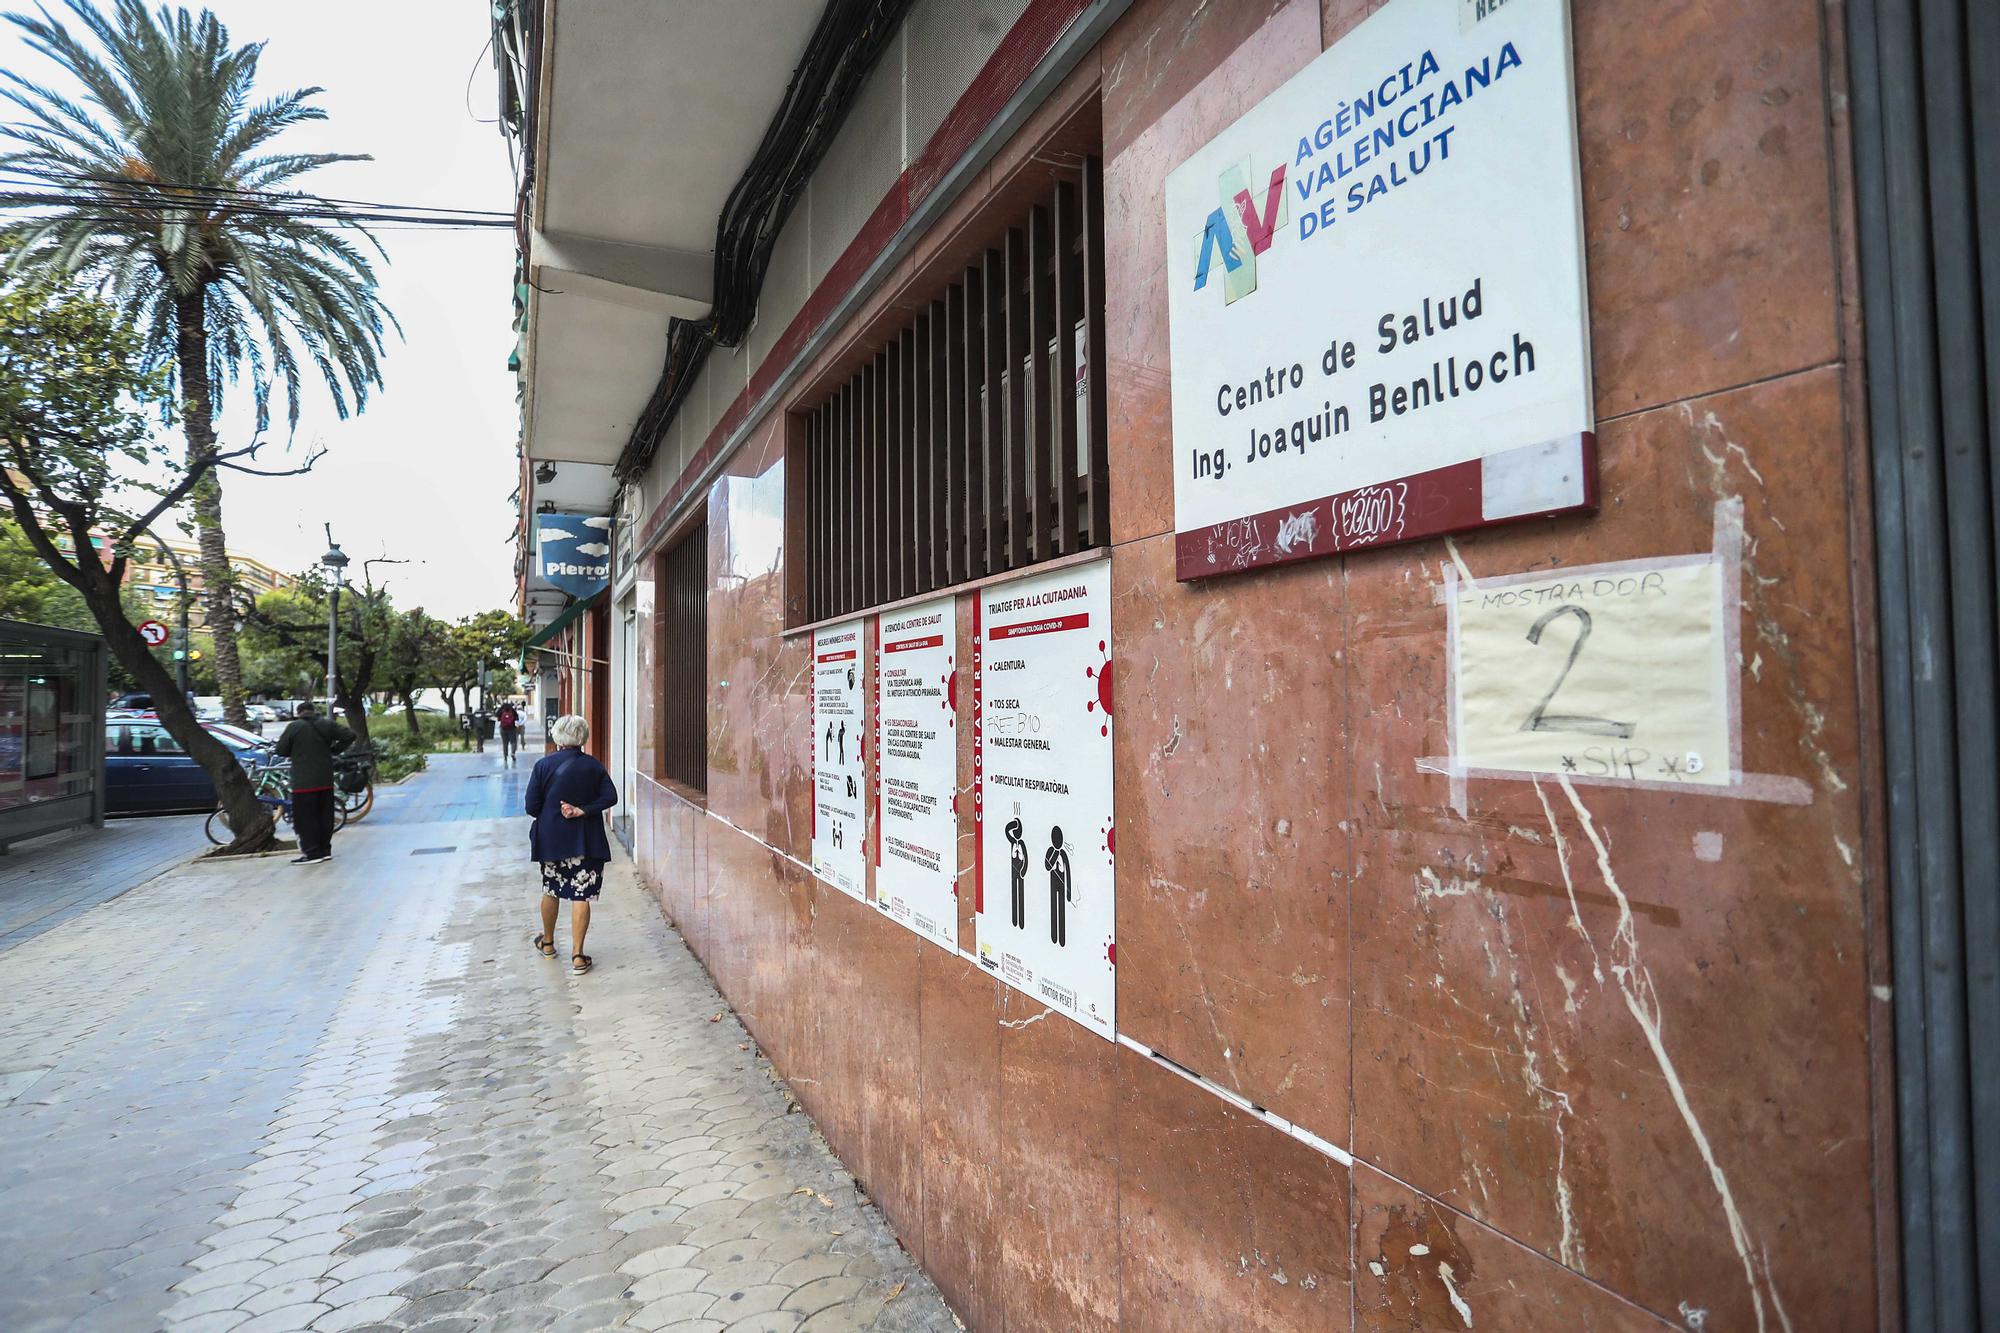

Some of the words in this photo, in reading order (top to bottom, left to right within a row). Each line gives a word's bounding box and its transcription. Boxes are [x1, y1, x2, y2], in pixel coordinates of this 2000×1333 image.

[1295, 49, 1440, 167] AGÈNCIA
[1296, 41, 1523, 201] VALENCIANA
[1300, 199, 1336, 241] DE
[1347, 126, 1455, 214] SALUT
[1217, 363, 1304, 417] Centro
[1322, 339, 1356, 376] de
[1378, 277, 1483, 354] Salud
[1193, 448, 1232, 480] Ing.
[1247, 401, 1350, 464] Joaquin
[1369, 333, 1536, 423] Benlloch
[989, 600, 1012, 615] TRIATGE
[1013, 598, 1025, 610] PER
[1026, 597, 1031, 607] A
[1032, 595, 1040, 606] LA
[1043, 585, 1087, 605] CIUTADANIA
[1482, 572, 1667, 609] MOSTRADOR
[906, 618, 921, 630] CENTRE
[922, 617, 928, 626] DE
[928, 614, 942, 625] SALUT
[994, 659, 1026, 671] CALENTURA
[1519, 604, 1637, 739] 2
[994, 699, 1005, 709] TOS
[1005, 699, 1020, 709] SECA
[924, 731, 936, 740] SALUT
[974, 635, 982, 822] CORONAVIRUS
[994, 737, 1022, 748] MALESTAR
[1023, 739, 1050, 751] GENERAL
[994, 774, 1024, 788] DIFICULTAT
[1025, 779, 1069, 795] RESPIRATÒRIA
[1041, 983, 1058, 1001] DOCTOR
[1059, 992, 1072, 1008] PESET
